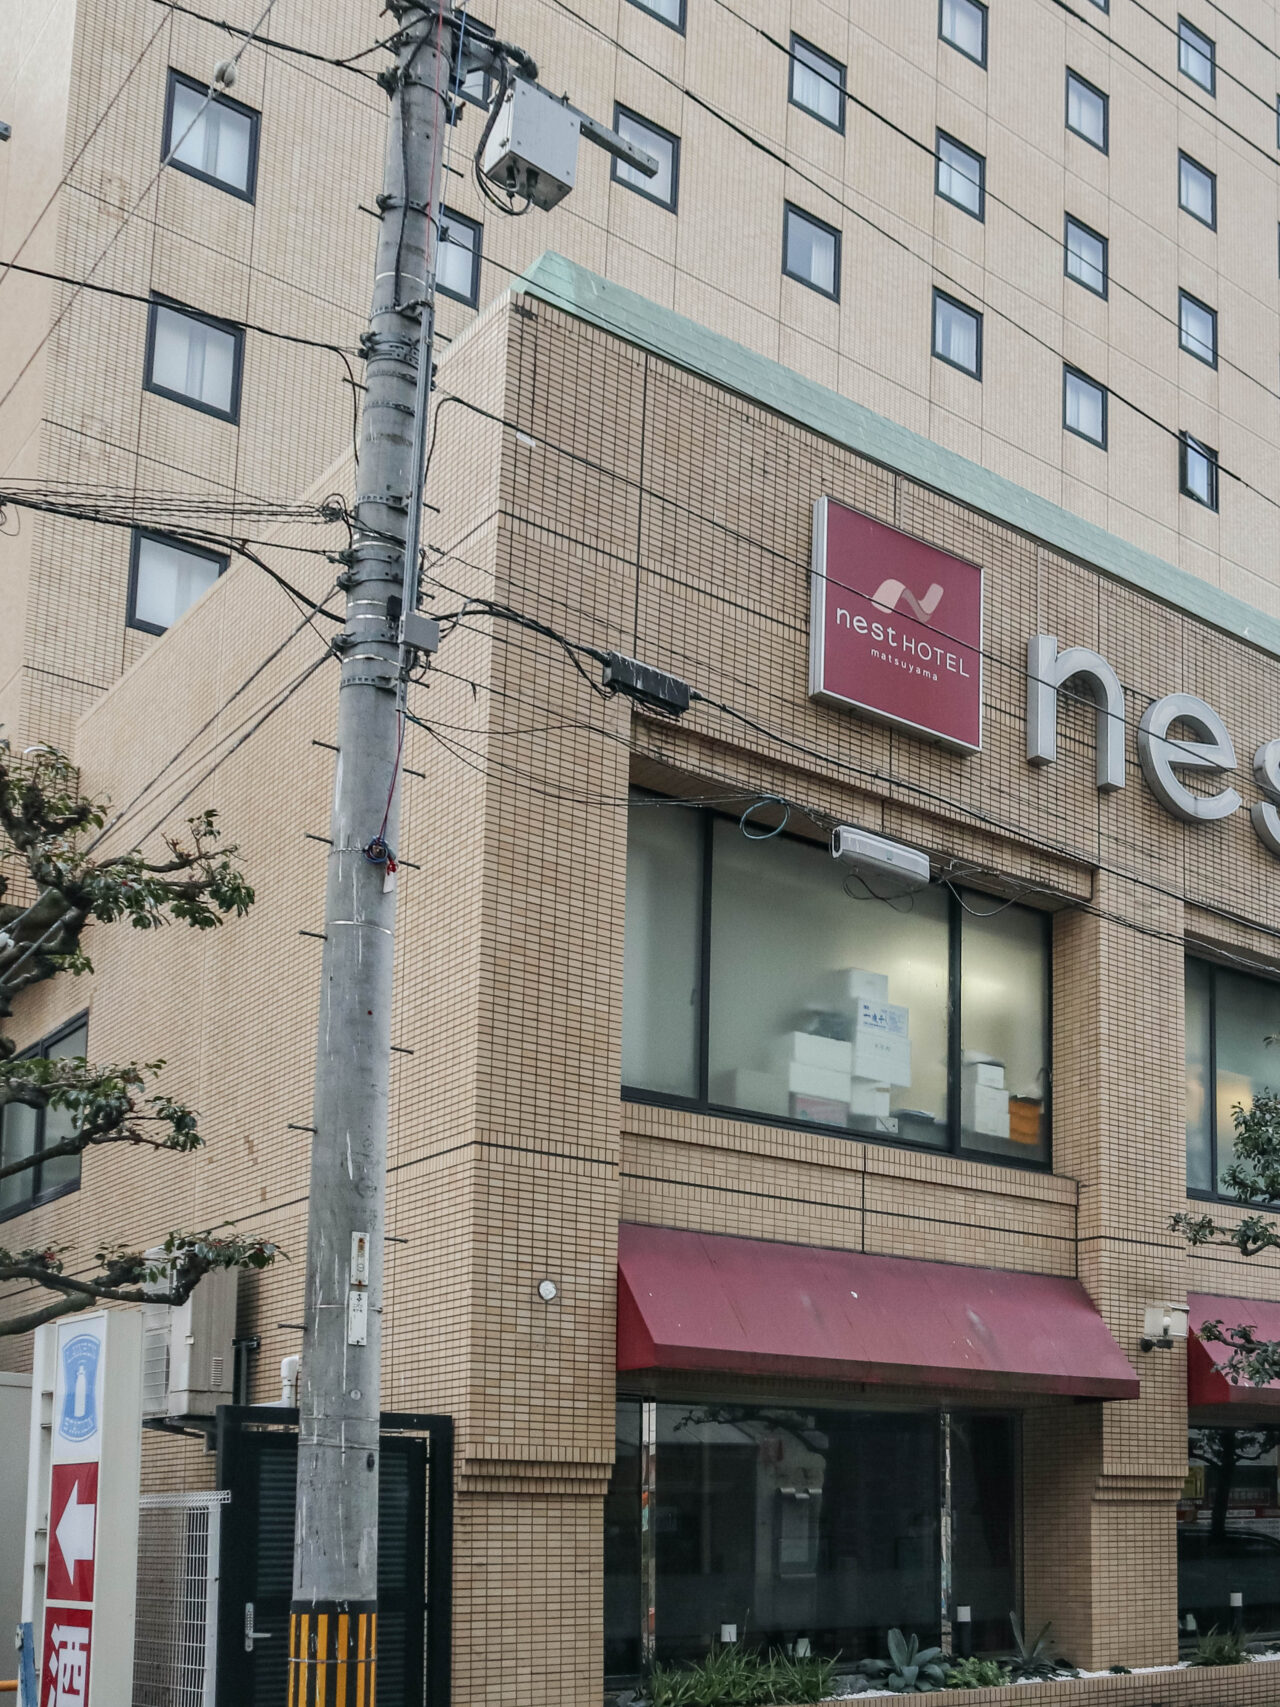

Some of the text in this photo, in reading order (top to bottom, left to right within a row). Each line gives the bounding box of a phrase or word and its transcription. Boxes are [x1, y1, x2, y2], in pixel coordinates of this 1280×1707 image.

[836, 607, 970, 678] nest HOTEL
[870, 648, 938, 681] matsuyama
